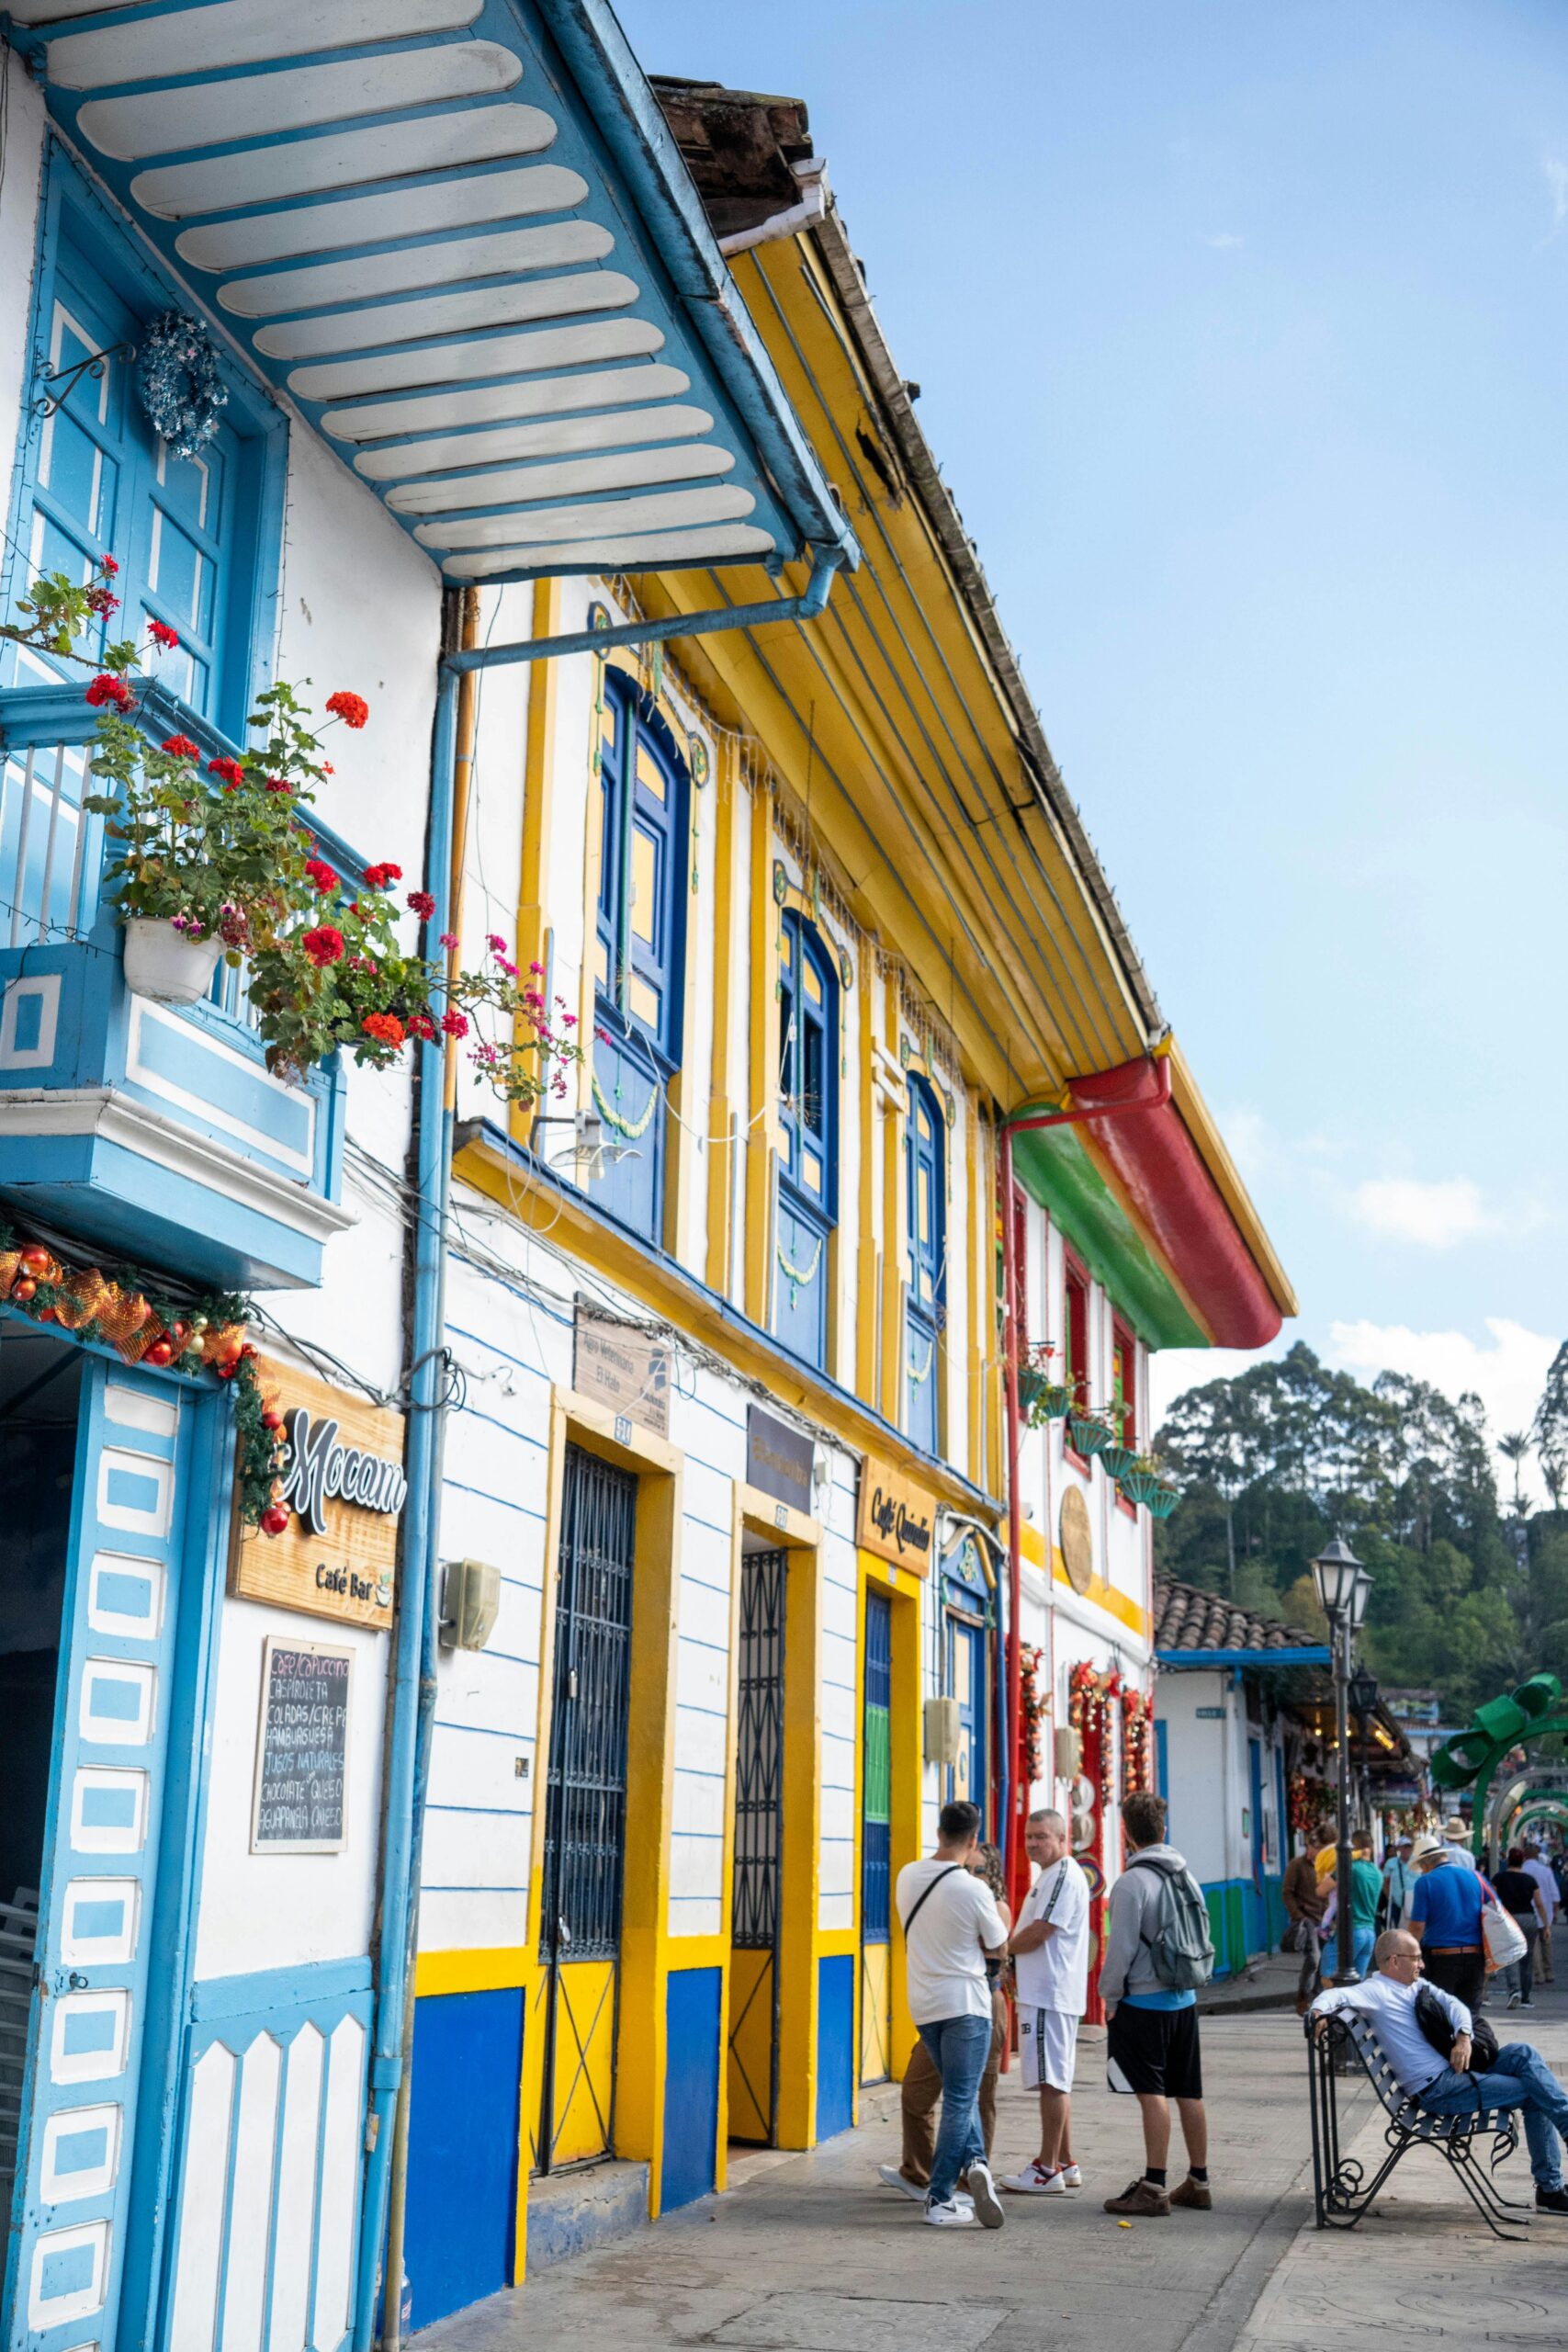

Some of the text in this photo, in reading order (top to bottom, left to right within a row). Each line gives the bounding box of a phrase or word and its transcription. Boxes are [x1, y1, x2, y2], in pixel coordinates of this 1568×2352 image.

[870, 1487, 896, 1540] Café
[316, 1564, 372, 1600] Café Bar
[265, 1750, 344, 1776] JUGOS NATURALES
[310, 1778, 343, 1800] QUESO
